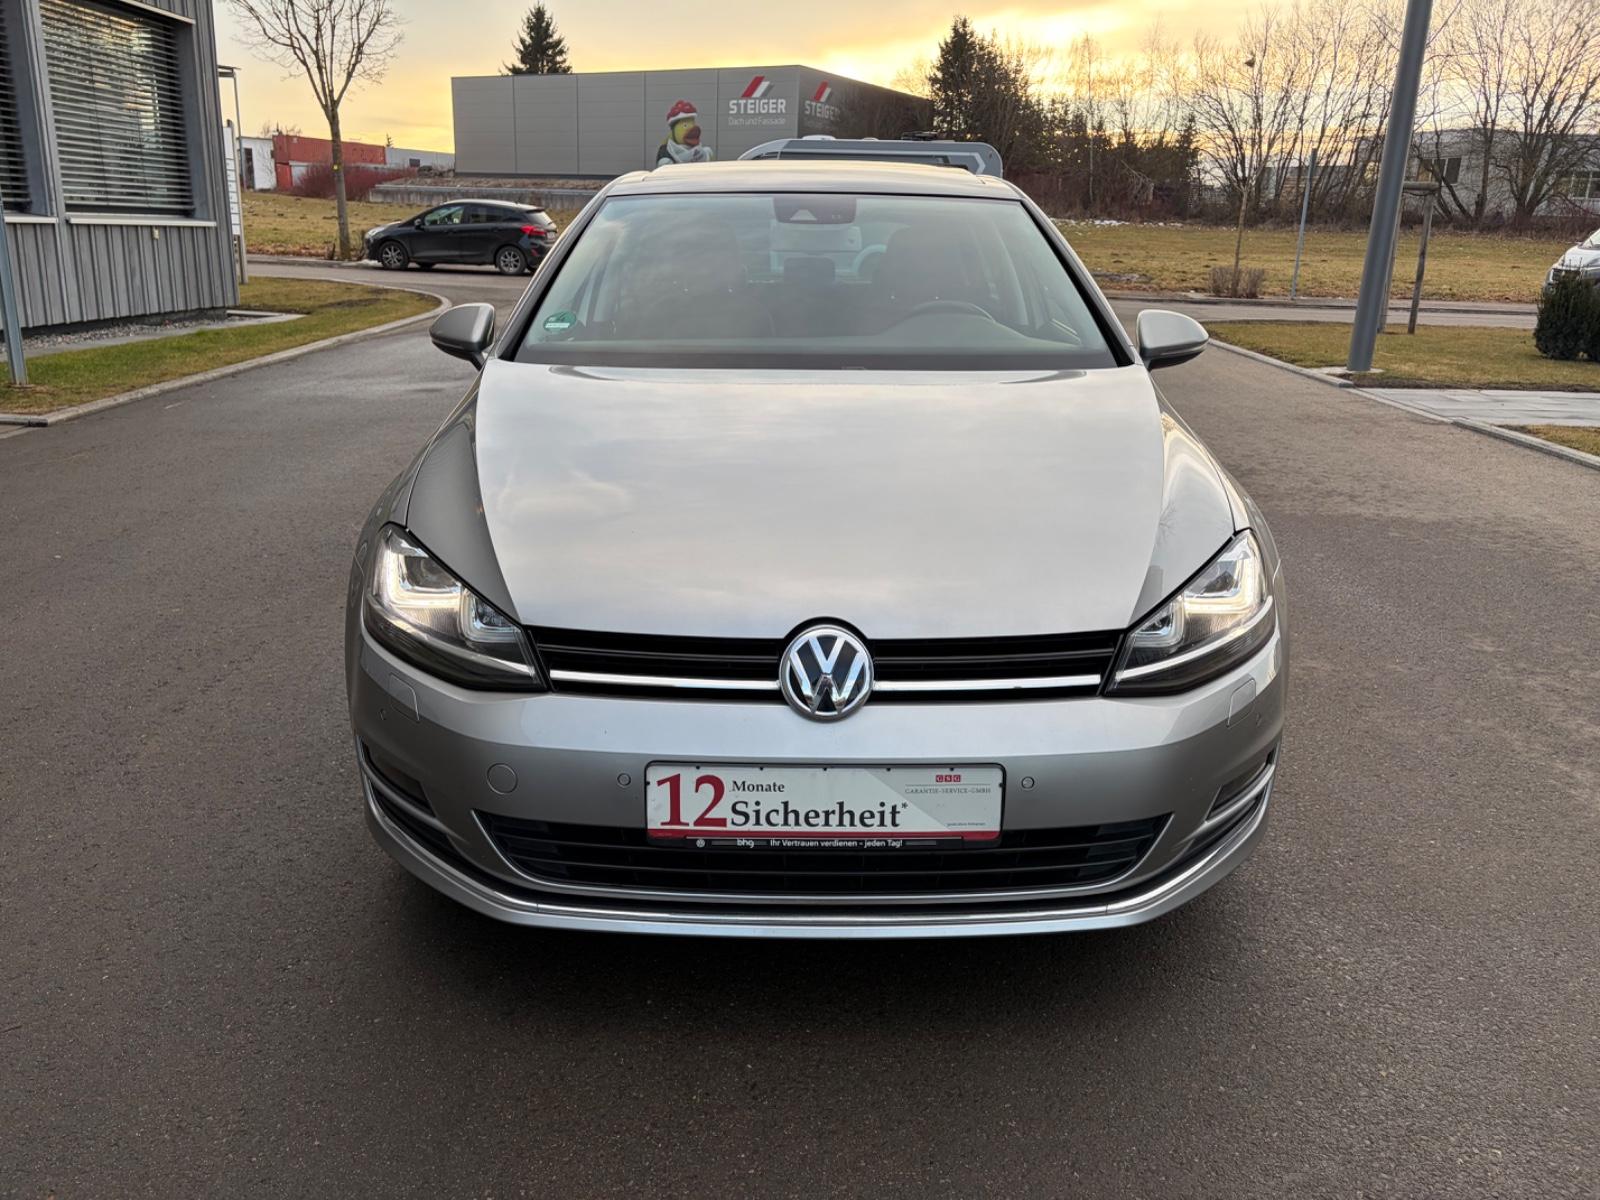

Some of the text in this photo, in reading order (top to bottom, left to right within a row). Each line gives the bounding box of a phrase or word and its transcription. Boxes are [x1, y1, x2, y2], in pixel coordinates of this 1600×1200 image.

[729, 99, 786, 114] STEIGER
[731, 780, 785, 793] Monate
[656, 773, 728, 828] 12
[736, 838, 755, 849] bhg
[770, 839, 781, 847] Ihr
[782, 839, 819, 847] Vertrauen
[820, 839, 858, 847] verdienen
[864, 839, 886, 849] jeden
[887, 839, 903, 849] Tag!
